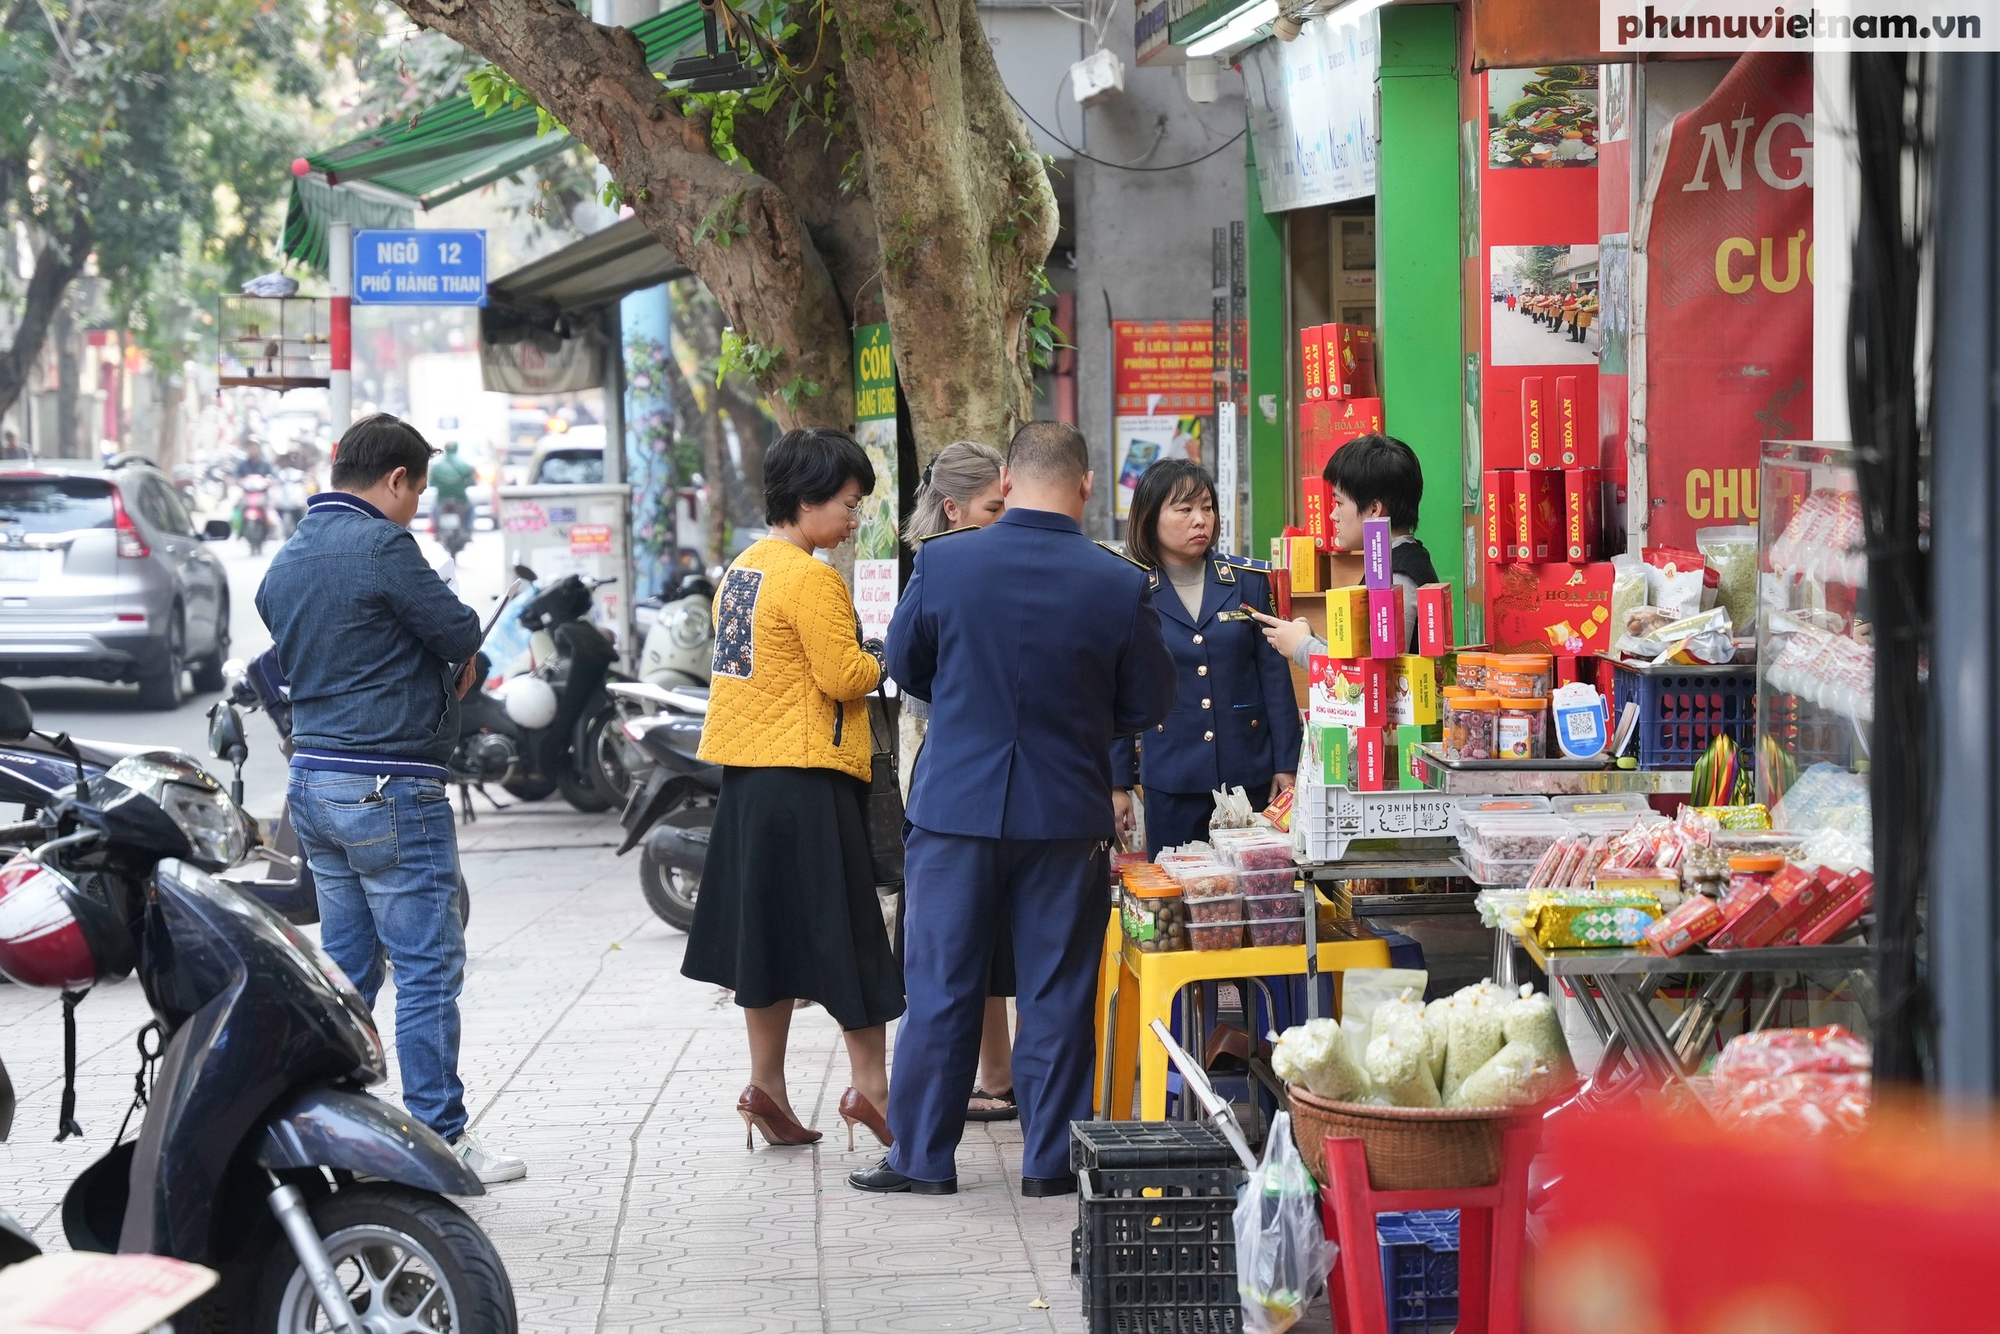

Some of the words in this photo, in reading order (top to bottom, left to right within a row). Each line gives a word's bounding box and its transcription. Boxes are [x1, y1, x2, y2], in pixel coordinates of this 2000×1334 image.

[377, 237, 419, 265] NGÕ
[438, 242, 462, 265] 12
[1715, 228, 1814, 294] CƯ
[361, 268, 392, 293] PHỐ
[395, 270, 438, 293] HÀNG
[441, 275, 481, 292] THAN
[860, 328, 891, 381] CỐM
[1312, 344, 1319, 360] AN
[1326, 341, 1334, 358] AN
[1328, 359, 1336, 383] HÒA
[1530, 399, 1538, 419] AN
[1564, 399, 1572, 418] AN
[1334, 419, 1353, 430] HÒA
[1354, 420, 1366, 429] AN
[1563, 420, 1572, 448] HÒA
[1529, 421, 1538, 449] HÒA
[1314, 494, 1320, 510] AN
[1488, 493, 1496, 512] AN
[1519, 493, 1526, 512] AN
[1570, 492, 1579, 512] AN
[1488, 515, 1496, 542] HÒA
[1519, 514, 1527, 542] HÒA
[1571, 514, 1579, 542] HÒA
[860, 563, 876, 580] Cốm
[875, 585, 891, 602] Cốm
[1545, 588, 1581, 601] HÒA
[1585, 590, 1608, 601] AN
[1387, 802, 1440, 812] SUNSHINE
